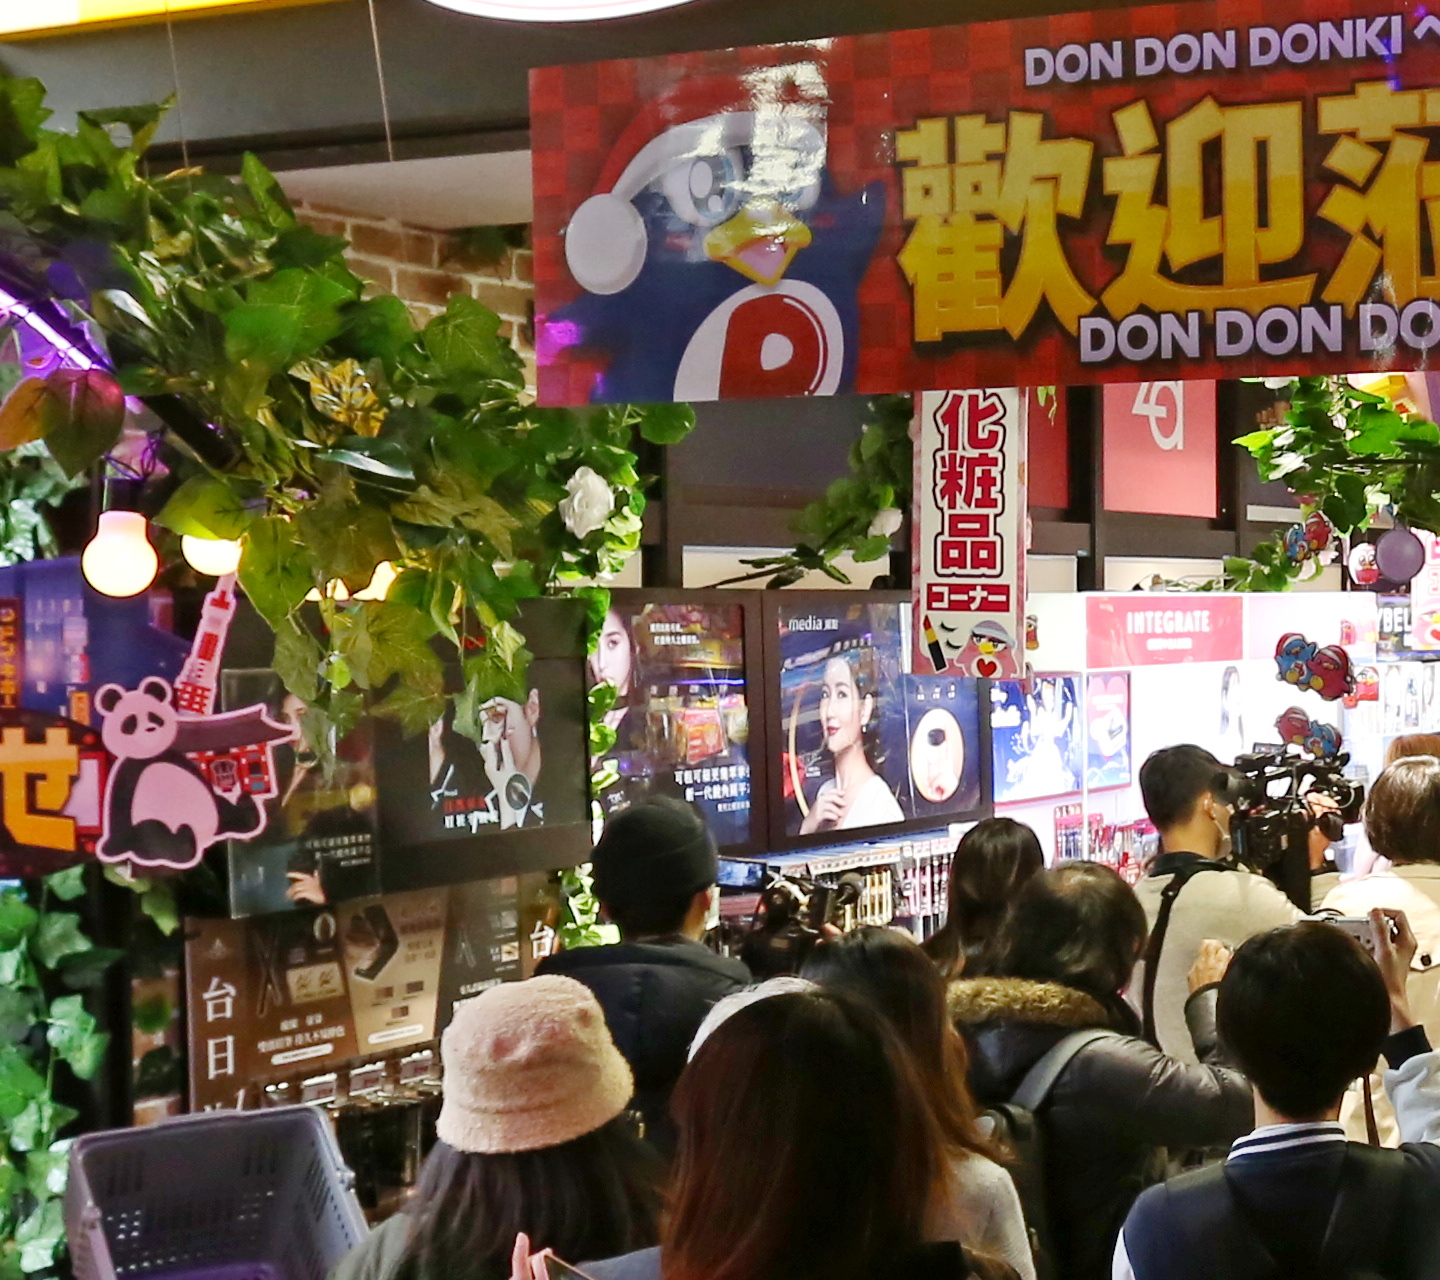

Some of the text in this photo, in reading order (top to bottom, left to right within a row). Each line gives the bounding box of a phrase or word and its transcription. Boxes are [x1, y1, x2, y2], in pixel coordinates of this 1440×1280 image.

[1024, 40, 1125, 88] DON
[1135, 28, 1237, 78] DON
[1249, 13, 1404, 68] DONKI
[1078, 311, 1206, 366] DON
[1215, 304, 1344, 358] DON
[936, 390, 1004, 575] 化粧品
[931, 586, 1009, 611] コーナー
[1126, 610, 1210, 636] INTEGRATE
